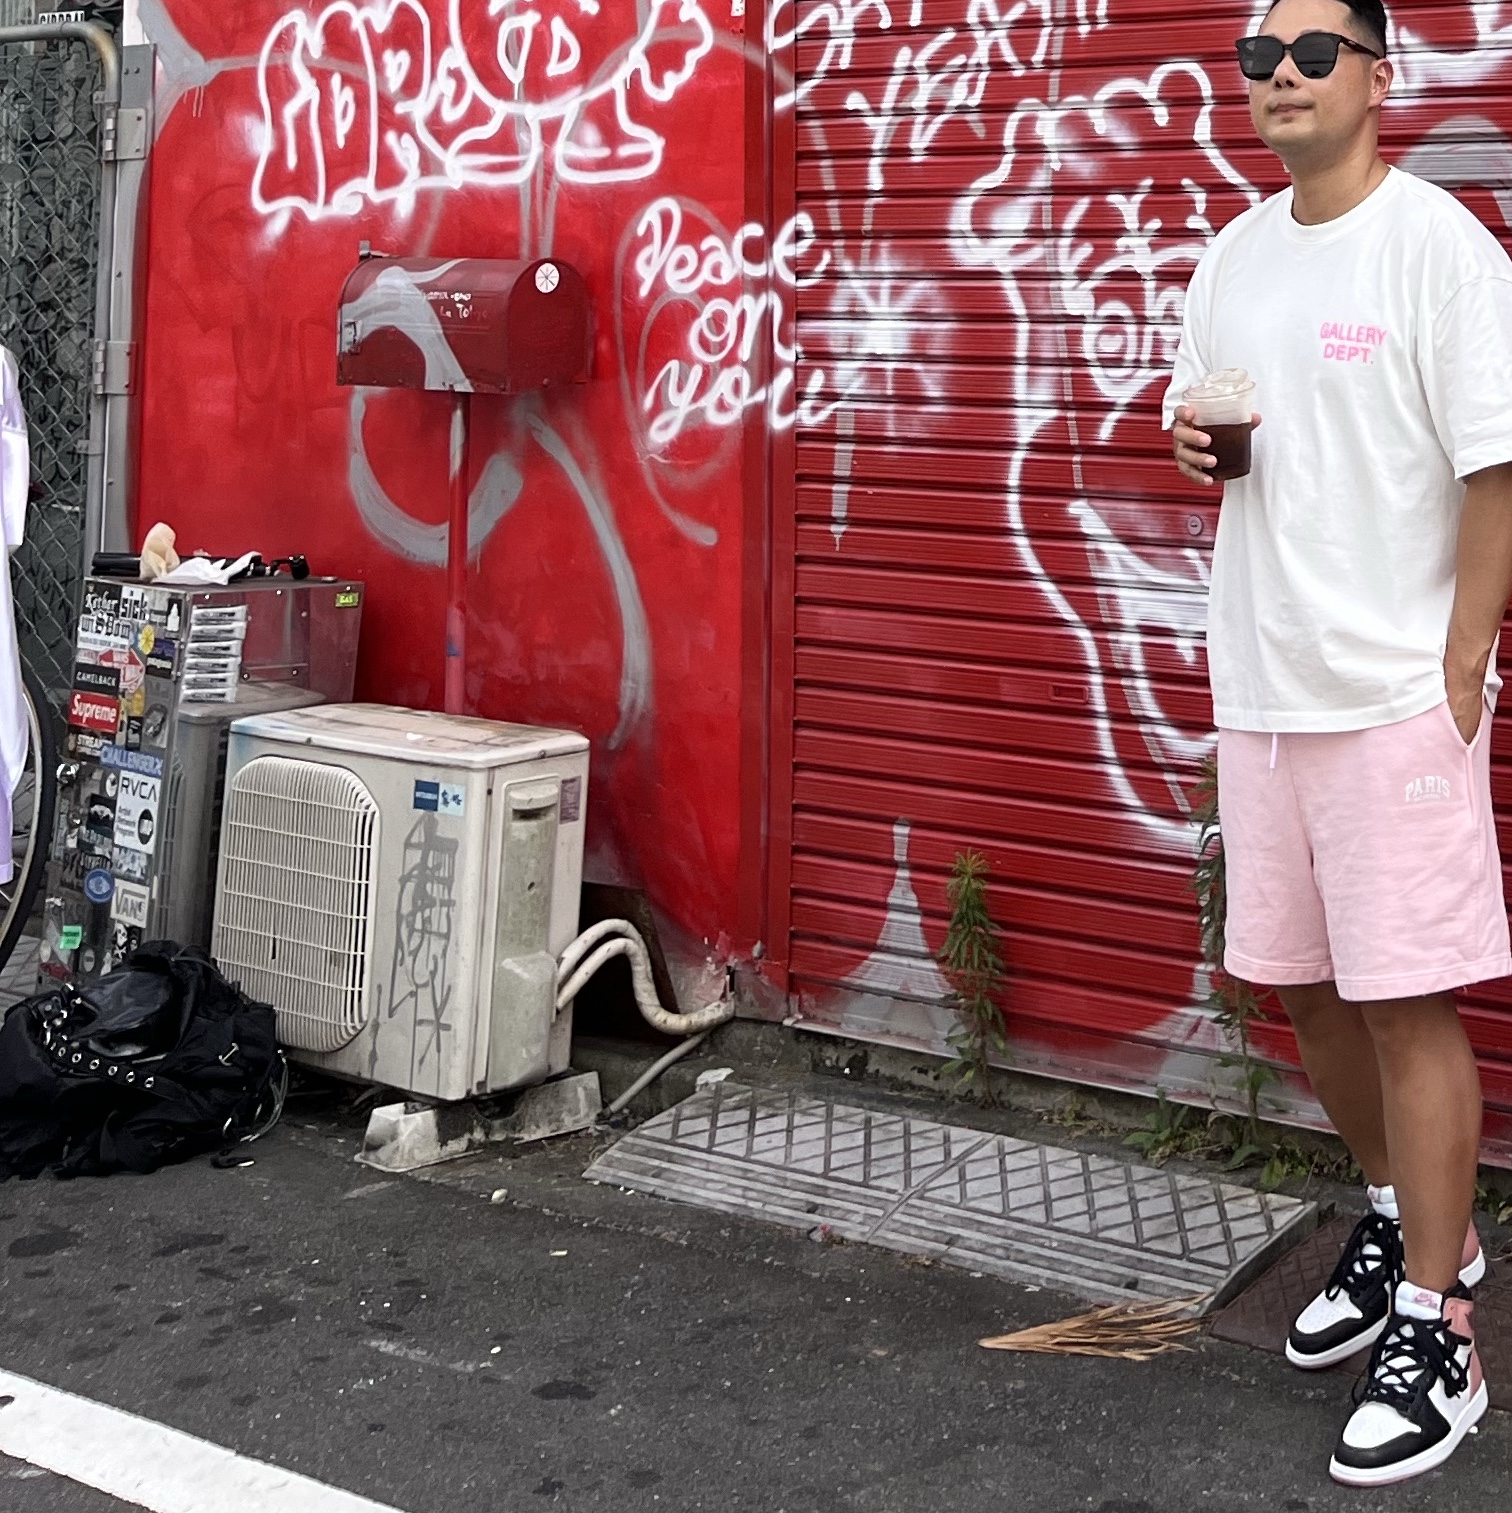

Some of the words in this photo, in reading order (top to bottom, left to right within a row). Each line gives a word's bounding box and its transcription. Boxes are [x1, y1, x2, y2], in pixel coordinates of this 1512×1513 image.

[634, 194, 833, 299] Peace
[688, 289, 805, 364] on
[1319, 321, 1388, 346] GALLERY
[1322, 342, 1375, 365] DEPT.
[642, 358, 852, 443] you
[71, 693, 118, 724] Supreme
[119, 776, 158, 804] RVCA
[1404, 775, 1451, 803] PARIS
[114, 886, 147, 923] VANS
